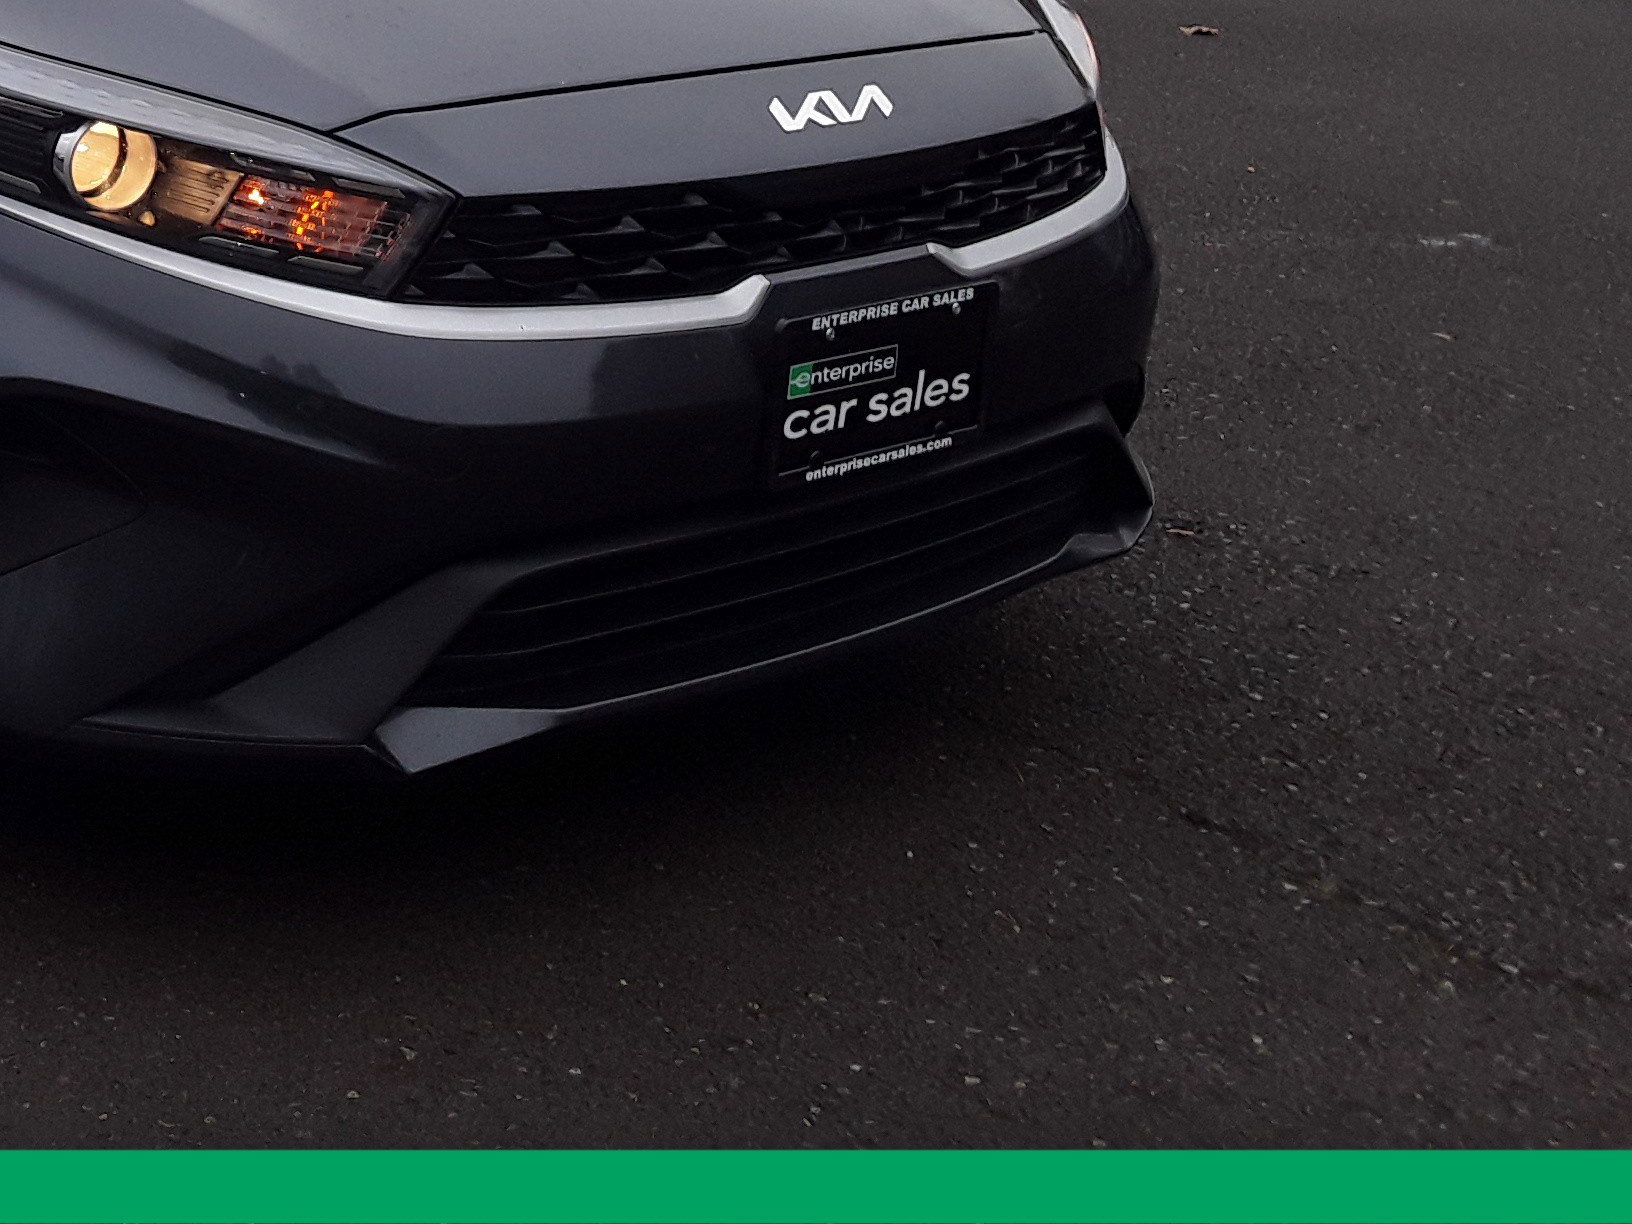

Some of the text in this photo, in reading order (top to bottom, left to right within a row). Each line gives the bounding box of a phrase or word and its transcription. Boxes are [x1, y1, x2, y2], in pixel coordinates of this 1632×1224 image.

[769, 84, 894, 133] KIA
[811, 287, 975, 331] ENTERPRISE CAR SALES
[790, 355, 895, 388] enterprise
[783, 369, 971, 440] car sales
[805, 436, 953, 482] enterprisecarsales.com
